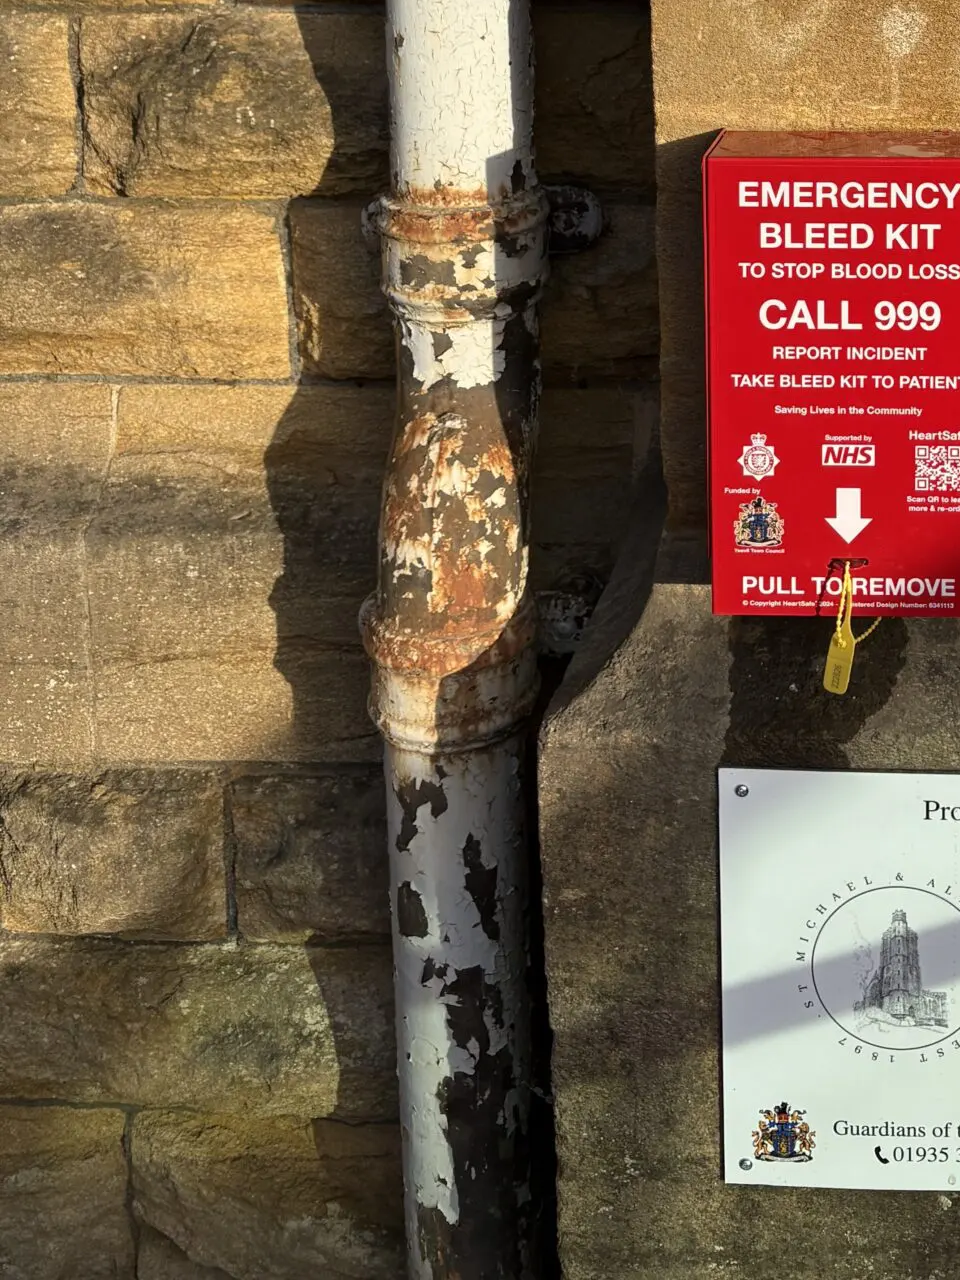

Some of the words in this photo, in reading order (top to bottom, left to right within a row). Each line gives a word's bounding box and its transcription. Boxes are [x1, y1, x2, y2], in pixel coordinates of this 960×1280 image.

[760, 223, 874, 248] BLEED
[886, 224, 941, 249] KIT
[739, 263, 765, 278] TO
[772, 263, 824, 278] STOP
[832, 263, 902, 279] BLOOD
[909, 264, 960, 279] LOSS
[760, 299, 862, 329] CALL
[875, 301, 941, 330] 999
[772, 347, 843, 360] REPORT
[847, 347, 927, 360] INCIDENT
[730, 375, 775, 388] TAKE
[779, 375, 836, 388] BLEED
[841, 375, 867, 388] KIT
[871, 376, 895, 389] TO
[774, 405, 808, 416] Saving
[809, 406, 836, 415] Lives
[837, 406, 847, 415] in
[848, 406, 865, 415] the
[866, 406, 923, 417] Community
[824, 433, 863, 442] Supported
[862, 433, 874, 444] by
[824, 446, 872, 464] NHS
[751, 487, 761, 496] by
[743, 576, 804, 594] PULL
[811, 577, 842, 595] TO
[852, 578, 955, 596] REMOVE
[749, 599, 782, 608] Copyright
[894, 873, 904, 882] &
[796, 876, 873, 962] MICHAEL
[839, 1038, 894, 1063] 1897
[920, 1039, 960, 1062] EST
[833, 1121, 925, 1137] Guardians
[933, 1123, 952, 1137] of
[893, 1147, 948, 1162] 01935
